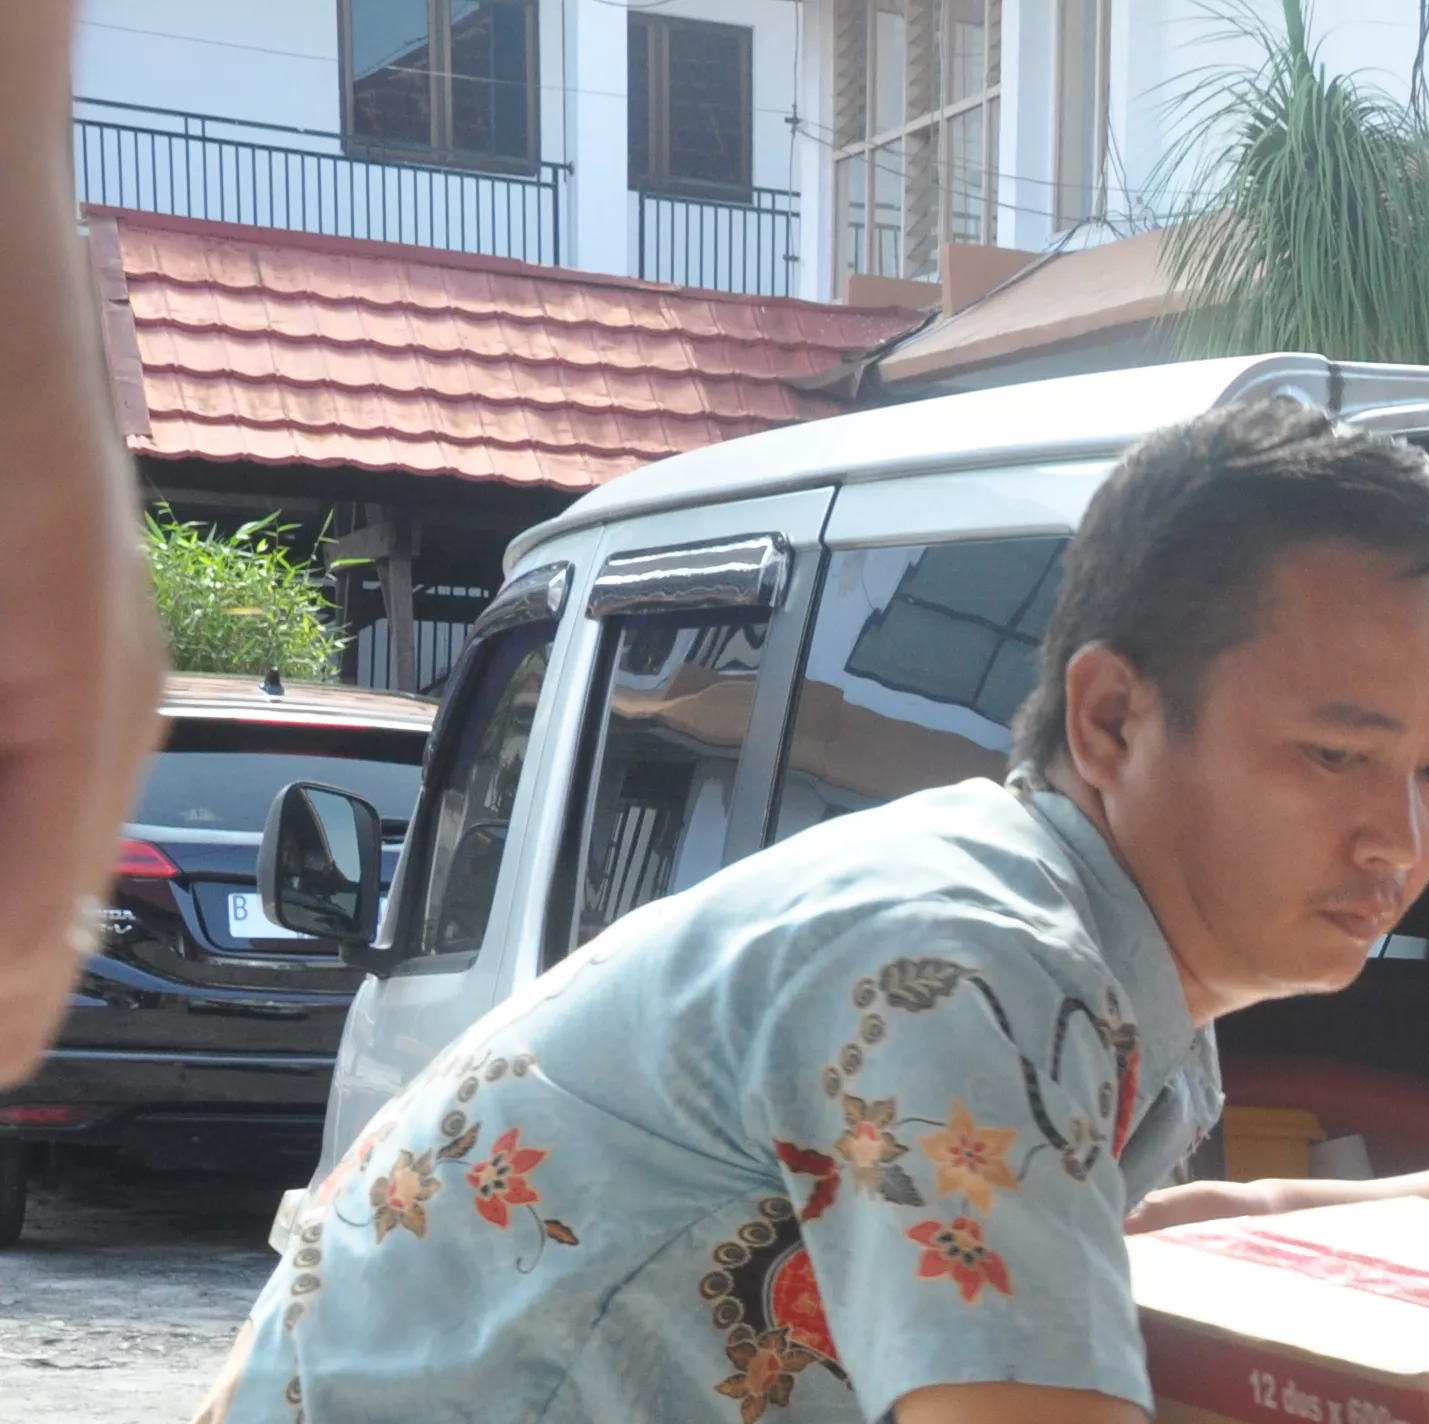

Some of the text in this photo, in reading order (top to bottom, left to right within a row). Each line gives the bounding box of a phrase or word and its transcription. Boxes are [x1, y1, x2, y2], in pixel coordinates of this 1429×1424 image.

[233, 895, 248, 921] B
[1249, 1368, 1278, 1409] 12
[1282, 1379, 1323, 1421] dus
